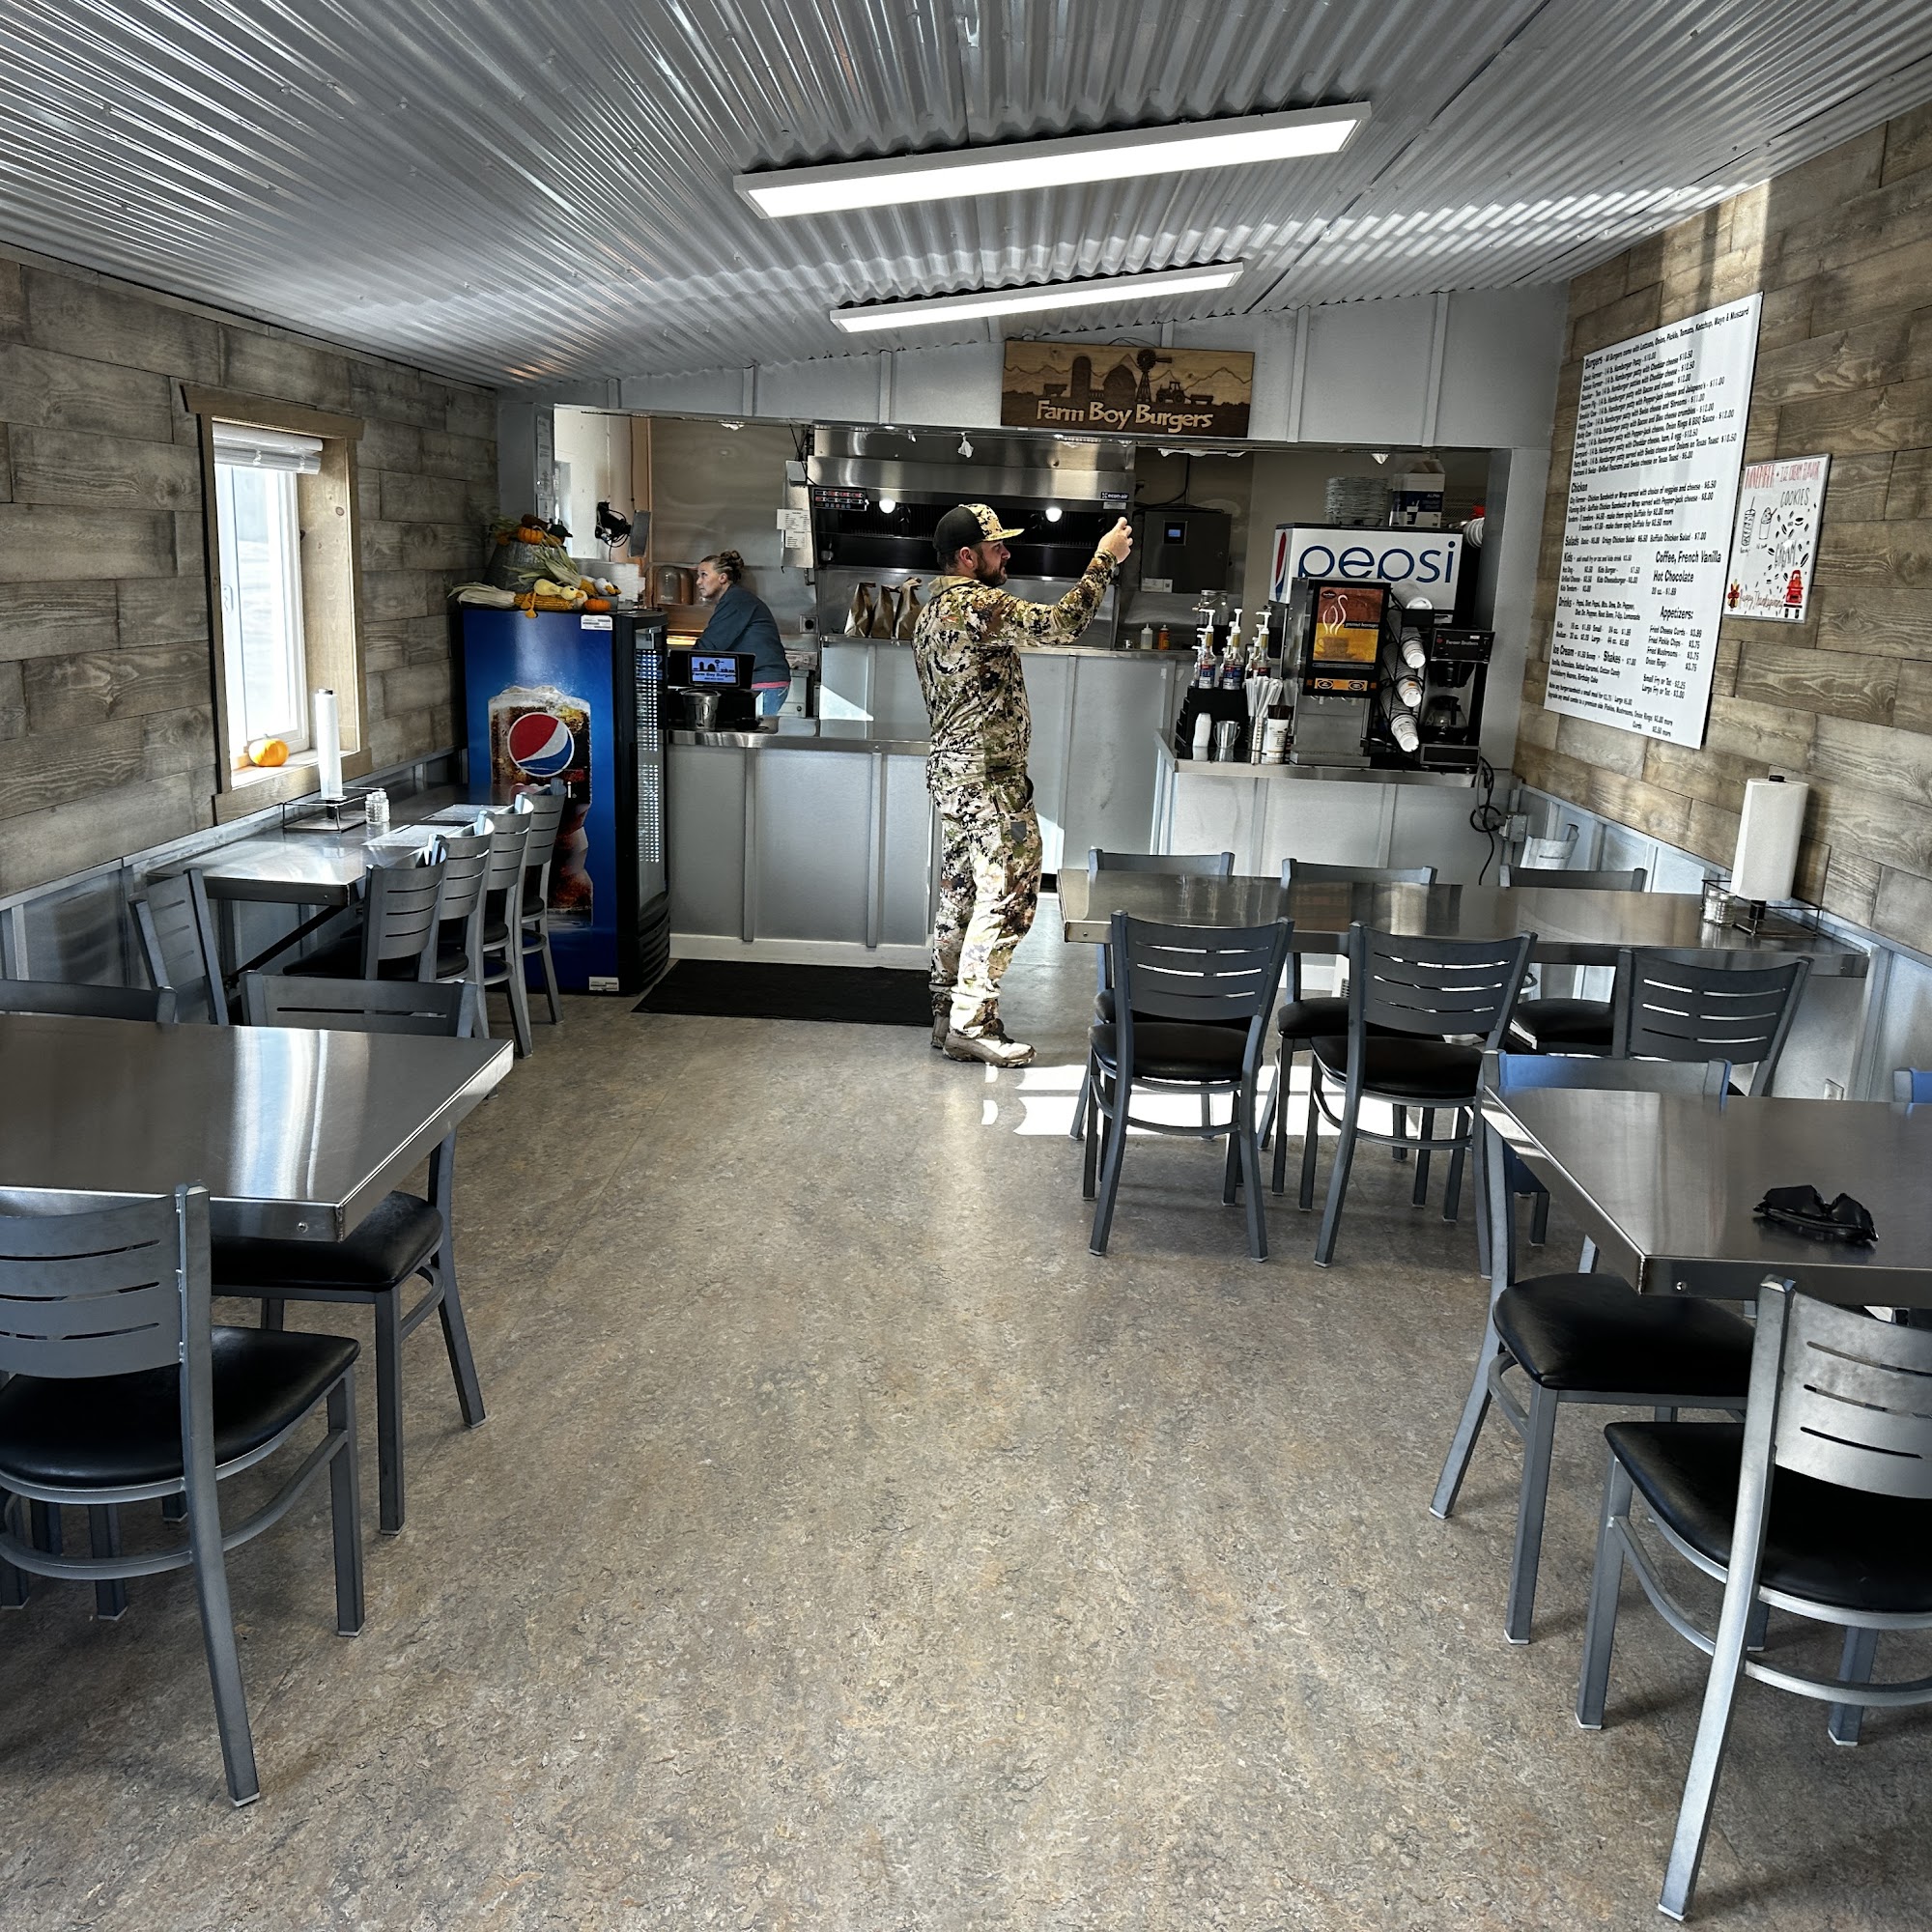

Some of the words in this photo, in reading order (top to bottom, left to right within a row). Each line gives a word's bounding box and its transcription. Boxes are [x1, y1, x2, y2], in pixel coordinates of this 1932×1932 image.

[1584, 356, 1603, 370] Burgers
[1730, 307, 1749, 320] Mustard
[1037, 399, 1084, 422] Farm
[1089, 401, 1132, 430] Boy
[1135, 403, 1213, 433] Burgers
[1701, 414, 1715, 424] Sauce
[1719, 409, 1735, 419] $12.00
[1571, 481, 1588, 494] Chicken
[1780, 488, 1810, 508] COOKIES
[1298, 540, 1456, 583] pepsi
[1656, 551, 1677, 565] Coffee,
[1677, 551, 1699, 563] French
[1701, 550, 1721, 563] Vanilla
[1653, 570, 1663, 582] Hot
[1664, 569, 1694, 582] Chocolate
[1660, 606, 1693, 621] Appetizers:
[1603, 650, 1621, 664] Shakes
